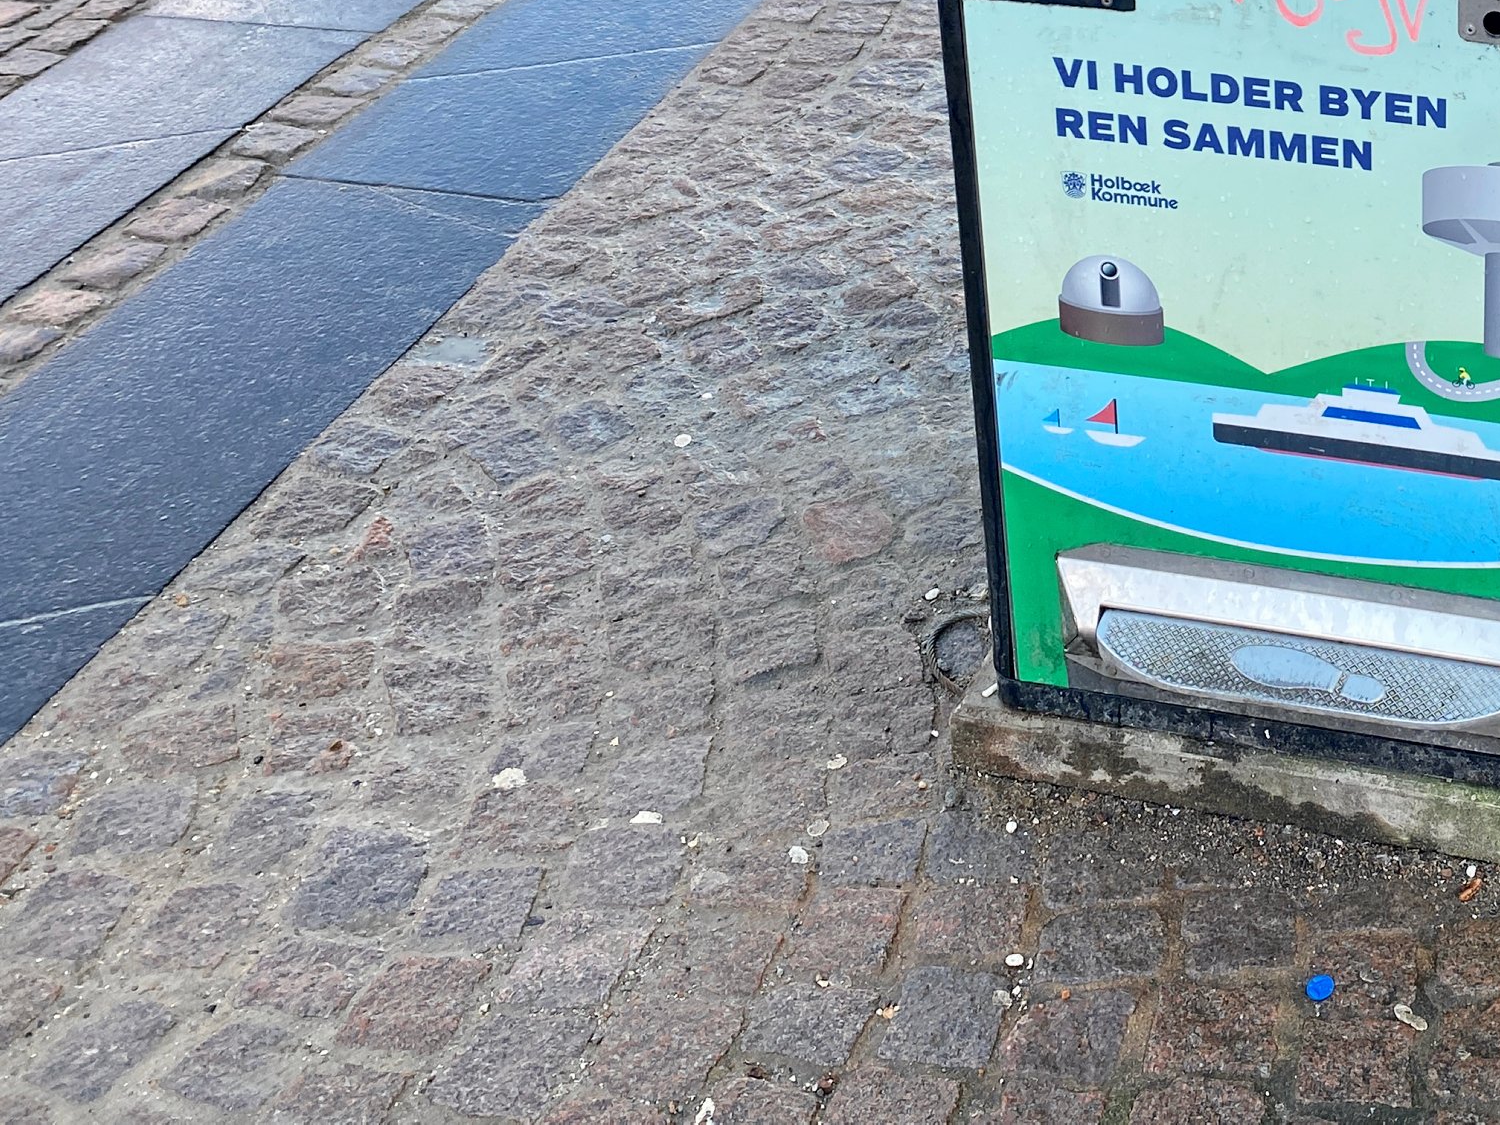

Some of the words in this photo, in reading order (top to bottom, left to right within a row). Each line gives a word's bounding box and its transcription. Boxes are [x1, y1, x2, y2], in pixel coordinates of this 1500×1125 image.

[1052, 56, 1098, 91] VI
[1113, 62, 1305, 113] HOLDER
[1319, 84, 1447, 129] BYEN
[1055, 107, 1148, 146] REN
[1163, 119, 1372, 171] SAMMEN
[1090, 173, 1162, 194] Holbæk
[1091, 186, 1178, 209] Kommune
